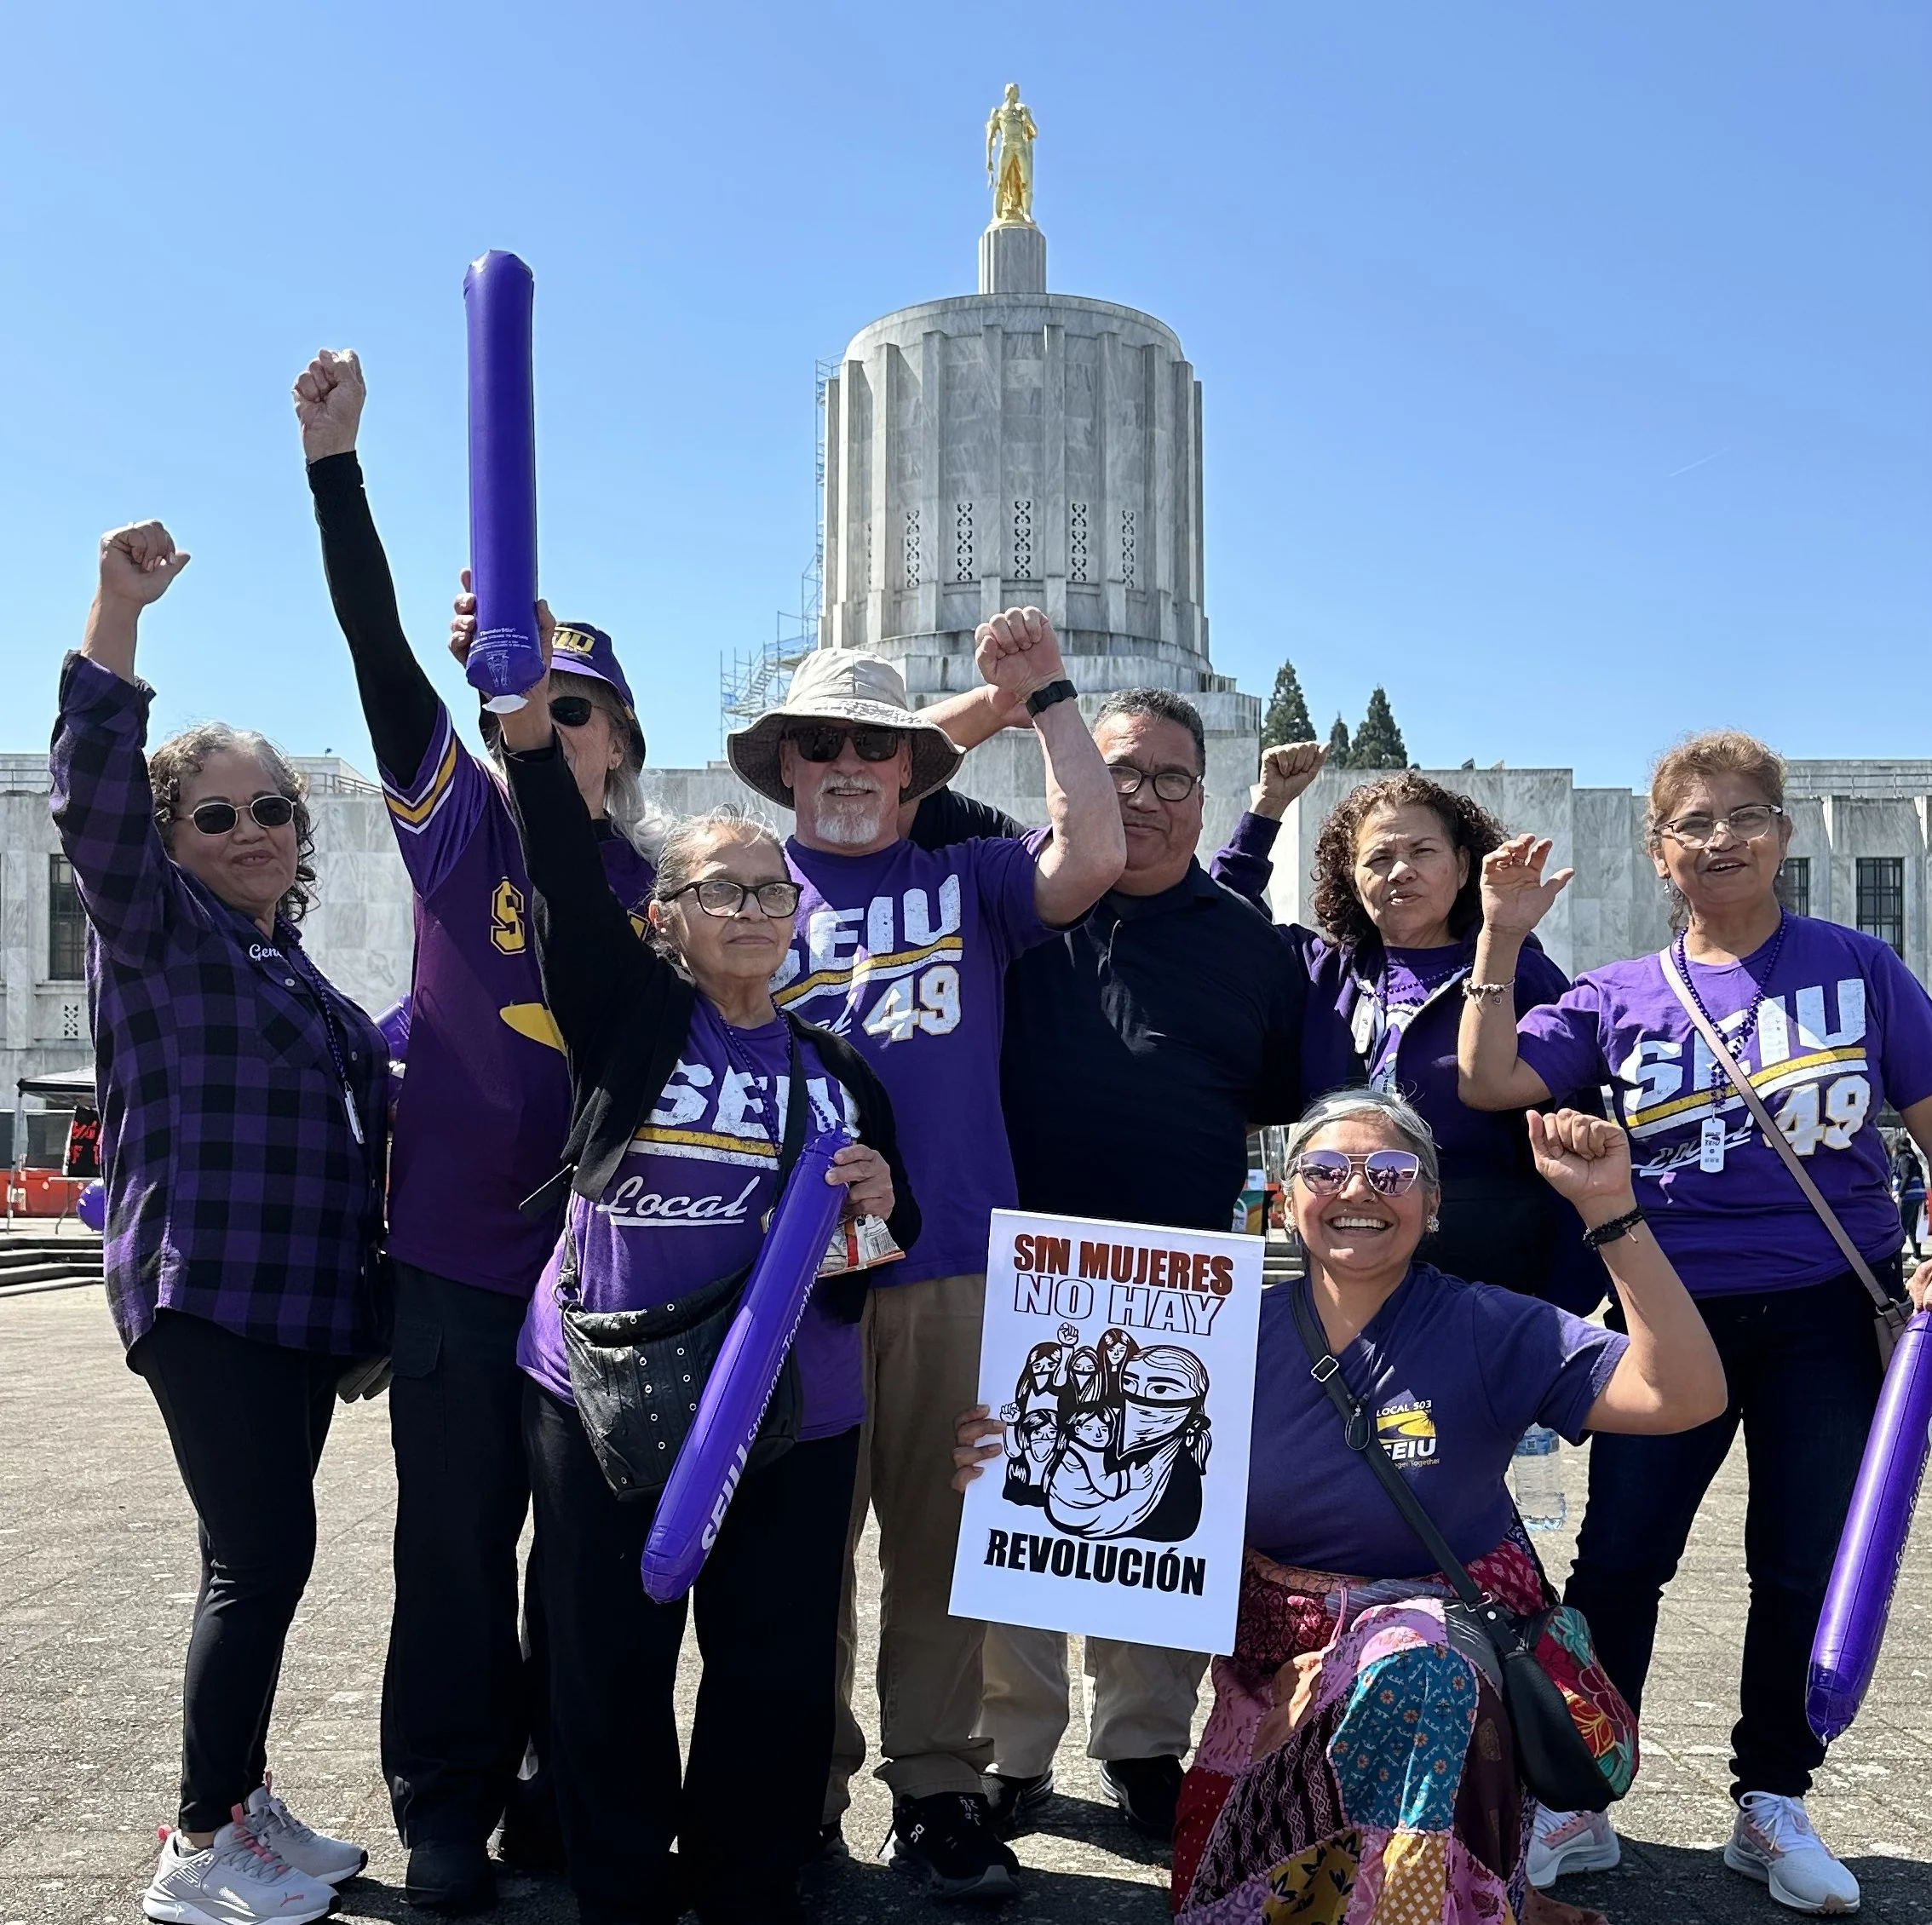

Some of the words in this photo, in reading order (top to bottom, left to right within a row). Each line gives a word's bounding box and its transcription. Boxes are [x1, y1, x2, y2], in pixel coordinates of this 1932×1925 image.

[861, 965, 961, 1043] 49
[1762, 1074, 1872, 1157] 49
[595, 1175, 762, 1219] Local
[1014, 1234, 1071, 1276] SIN
[1078, 1241, 1234, 1296] MUJERES
[1015, 1273, 1094, 1320] NO
[1108, 1284, 1226, 1336] HAY
[1376, 1404, 1410, 1417] LOCAL
[1412, 1399, 1432, 1411] 503
[983, 1527, 1207, 1597] REVOLUCIÓN
